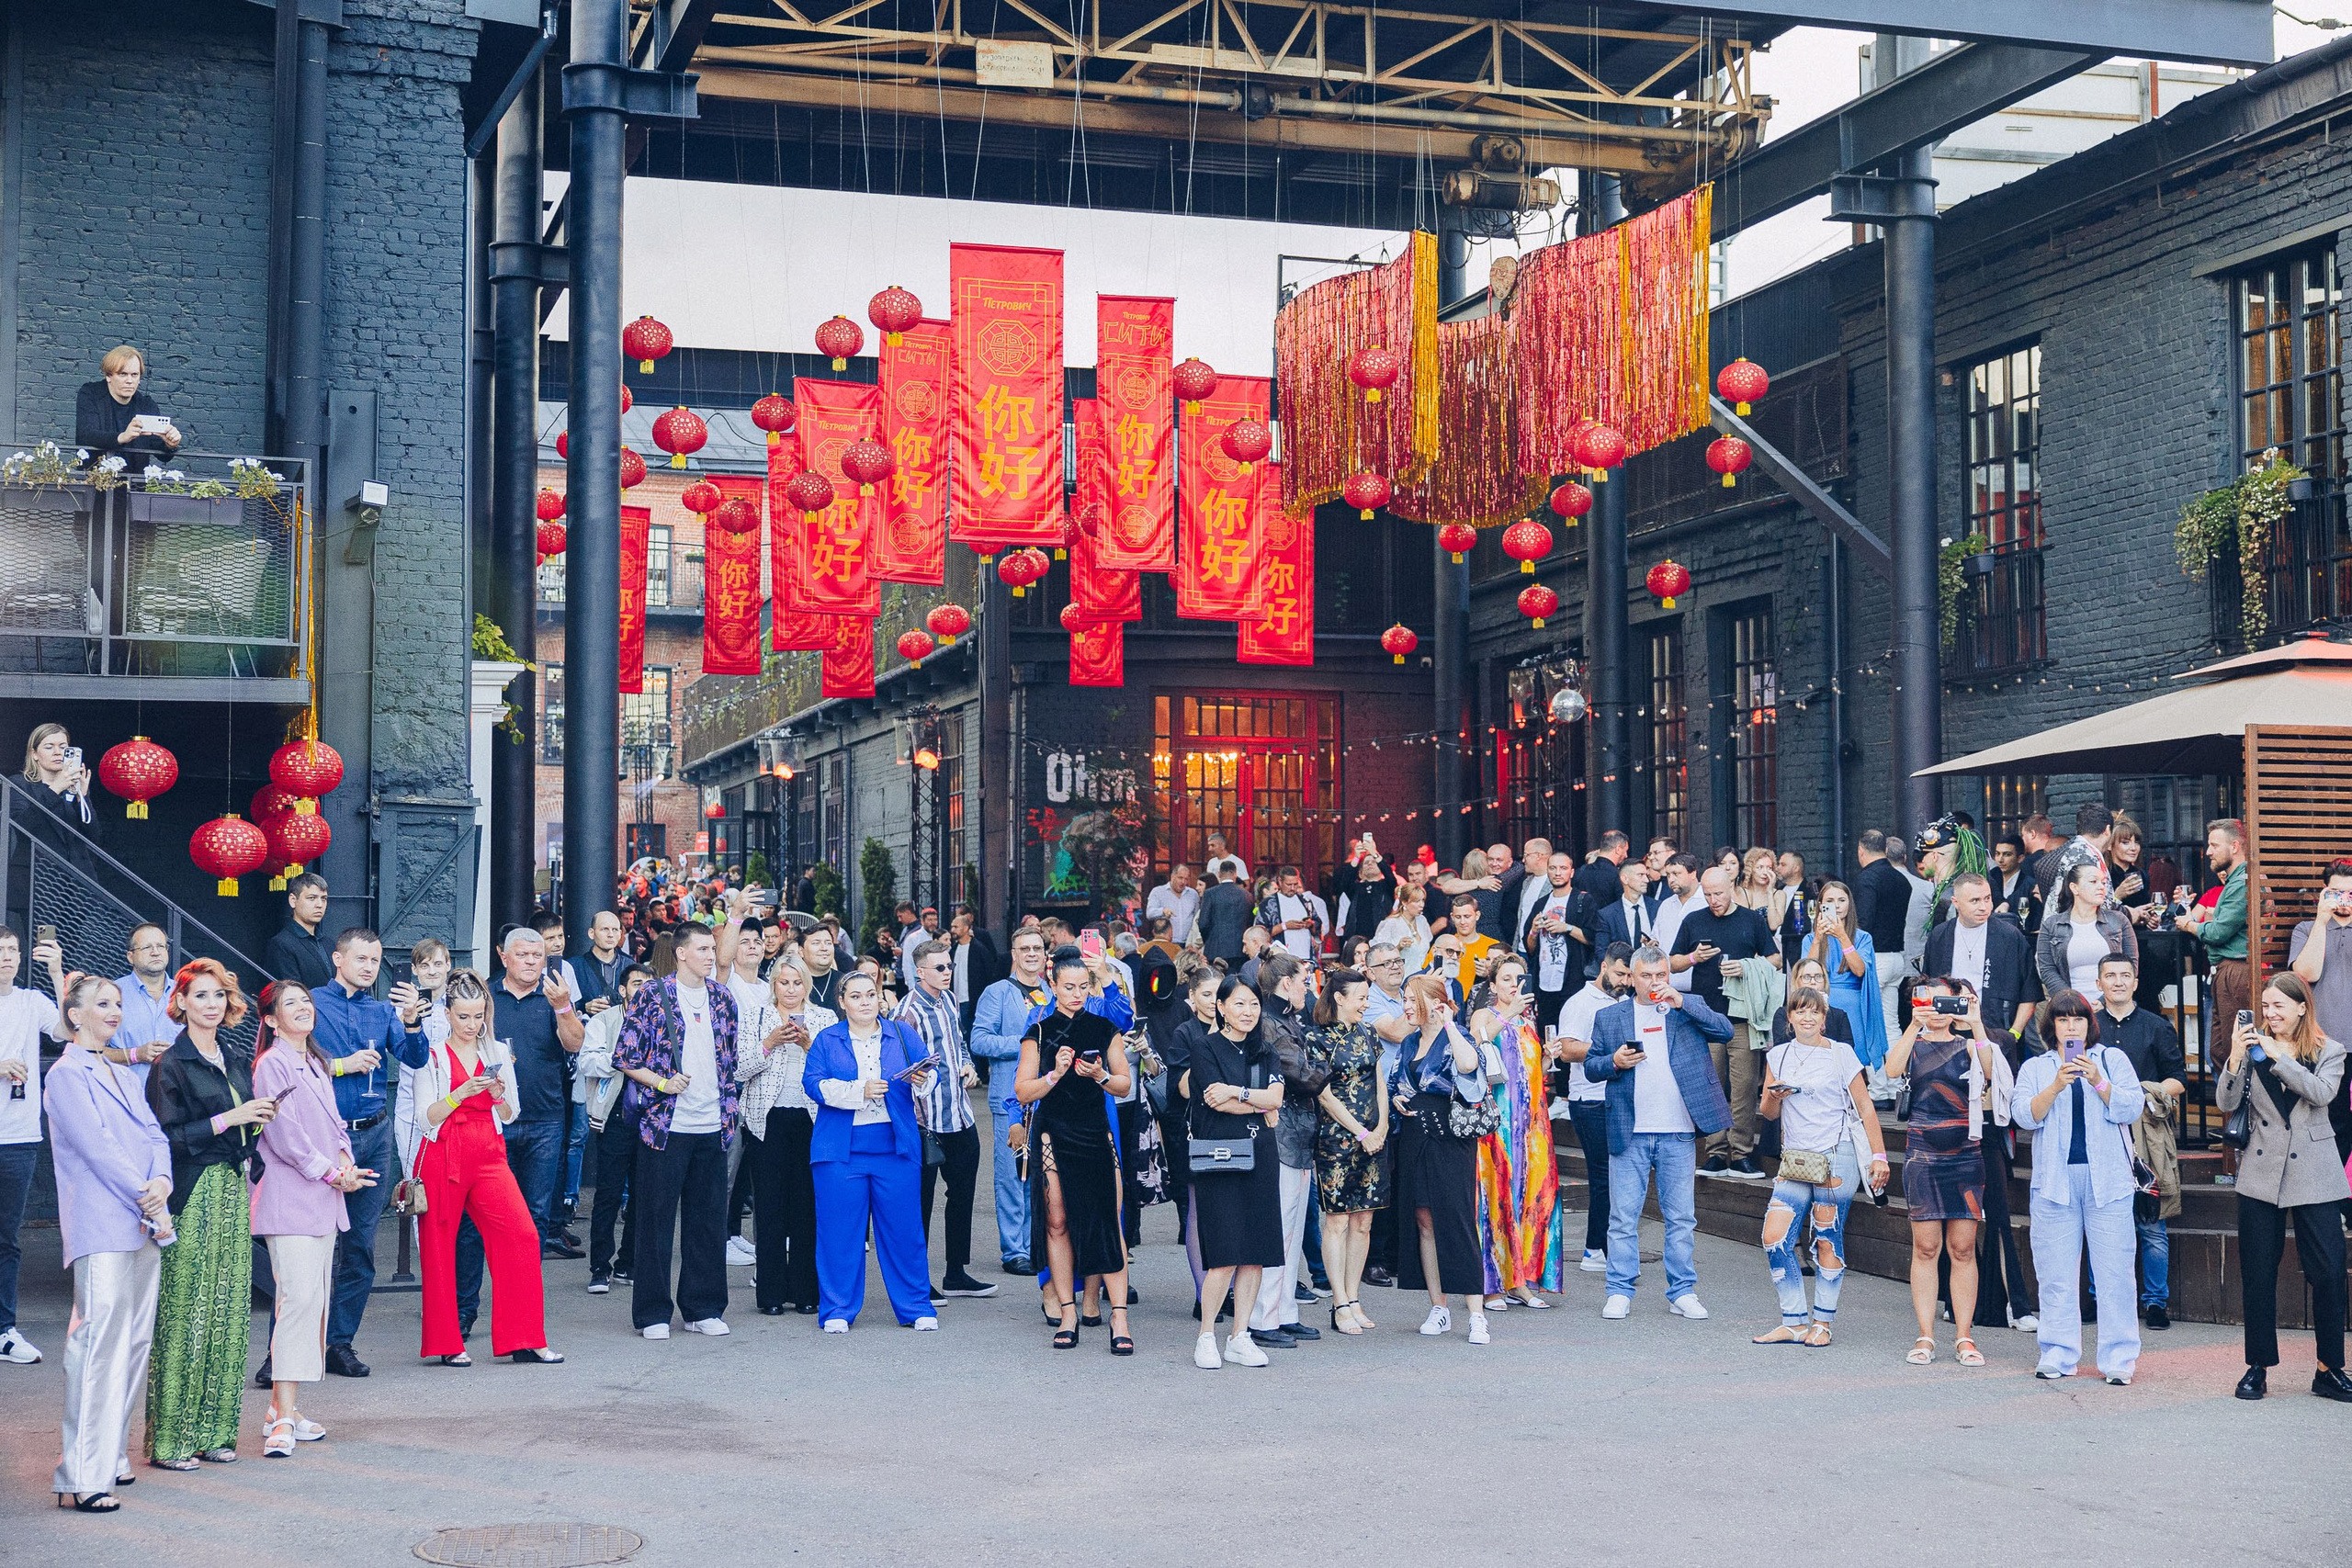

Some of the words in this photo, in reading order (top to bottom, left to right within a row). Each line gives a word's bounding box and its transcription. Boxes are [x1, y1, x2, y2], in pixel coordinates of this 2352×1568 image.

[898, 349, 937, 367] СИТИ
[1104, 321, 1166, 349] СИТИ
[891, 426, 933, 509] 你好
[976, 384, 1042, 501] 你好
[1115, 413, 1158, 500] 你好
[810, 491, 863, 583] 你好
[1199, 487, 1251, 584] 你好
[718, 558, 751, 619] 你好
